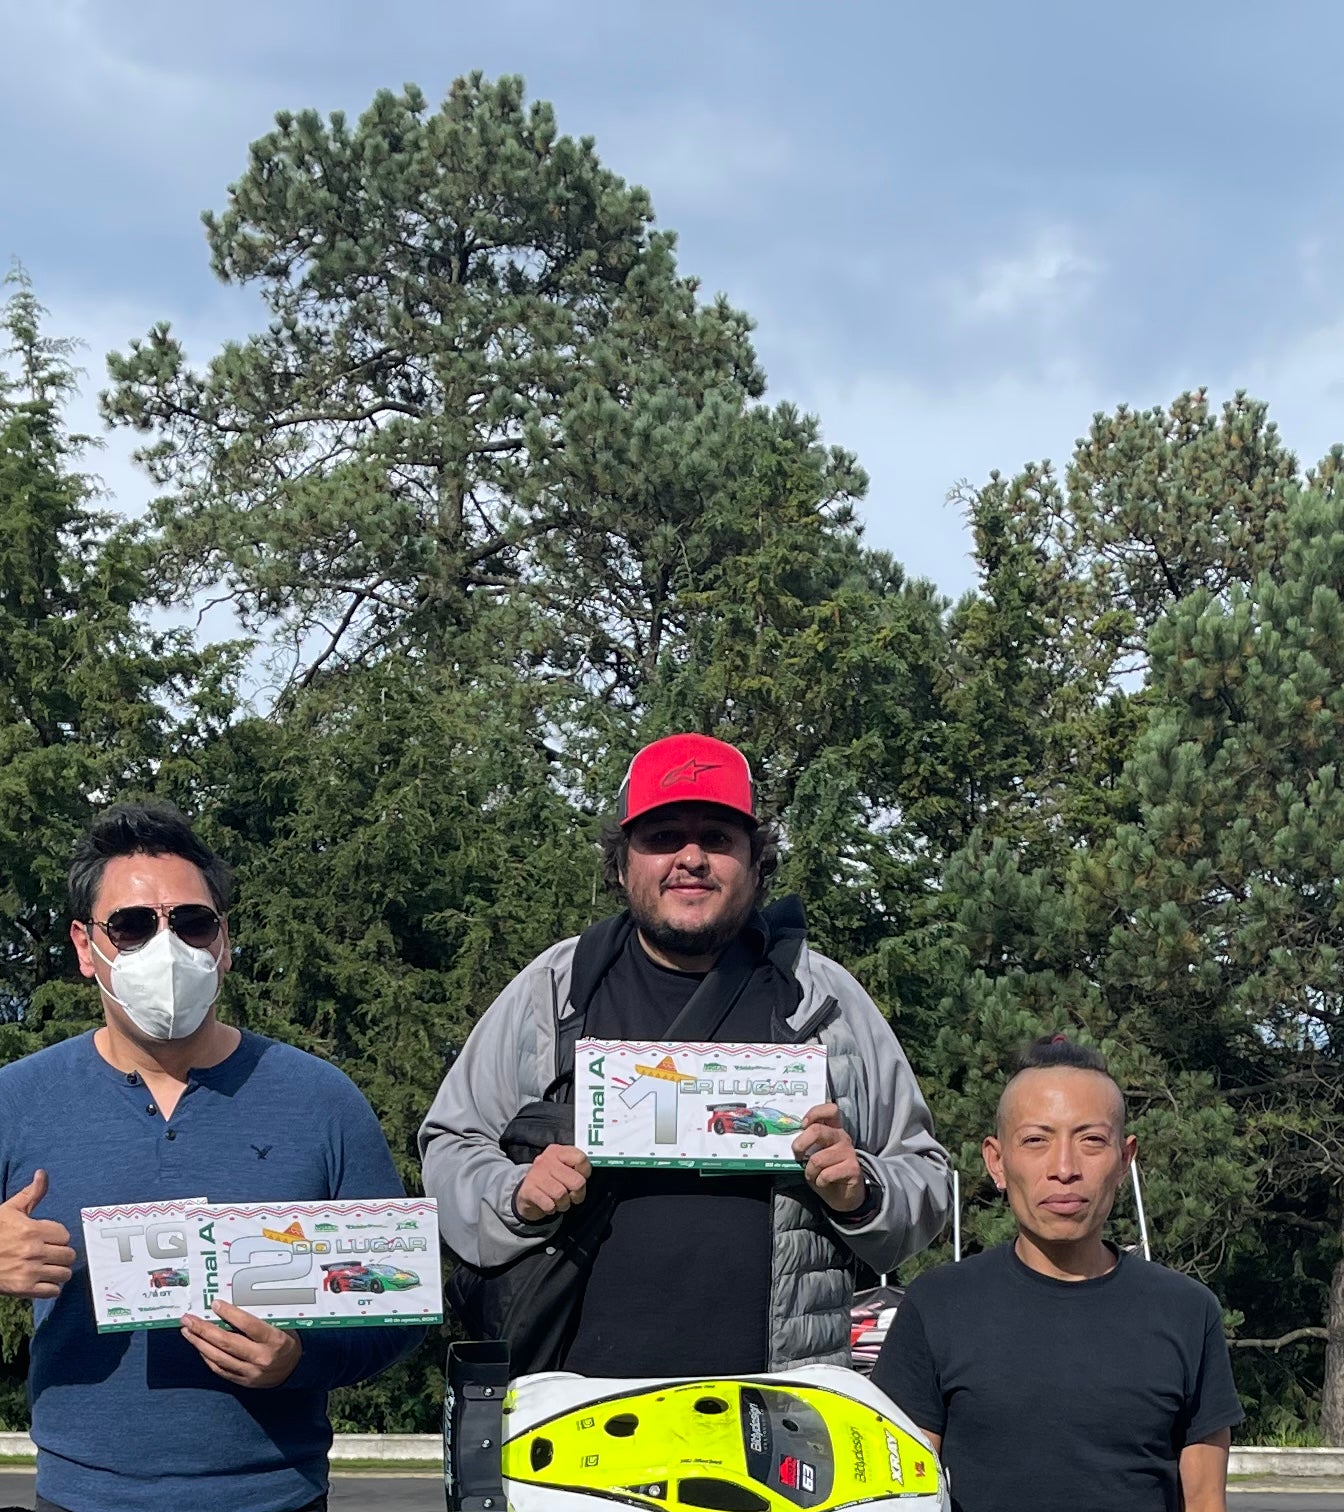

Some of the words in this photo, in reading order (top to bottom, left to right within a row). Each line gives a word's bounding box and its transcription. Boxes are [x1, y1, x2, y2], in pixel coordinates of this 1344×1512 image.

[588, 1056, 605, 1079] A
[719, 1079, 808, 1096] LUGAR
[588, 1085, 605, 1146] Final
[200, 1221, 217, 1245] A
[336, 1236, 427, 1254] LUGAR
[202, 1252, 220, 1310] Final
[884, 1427, 904, 1487] XRAY
